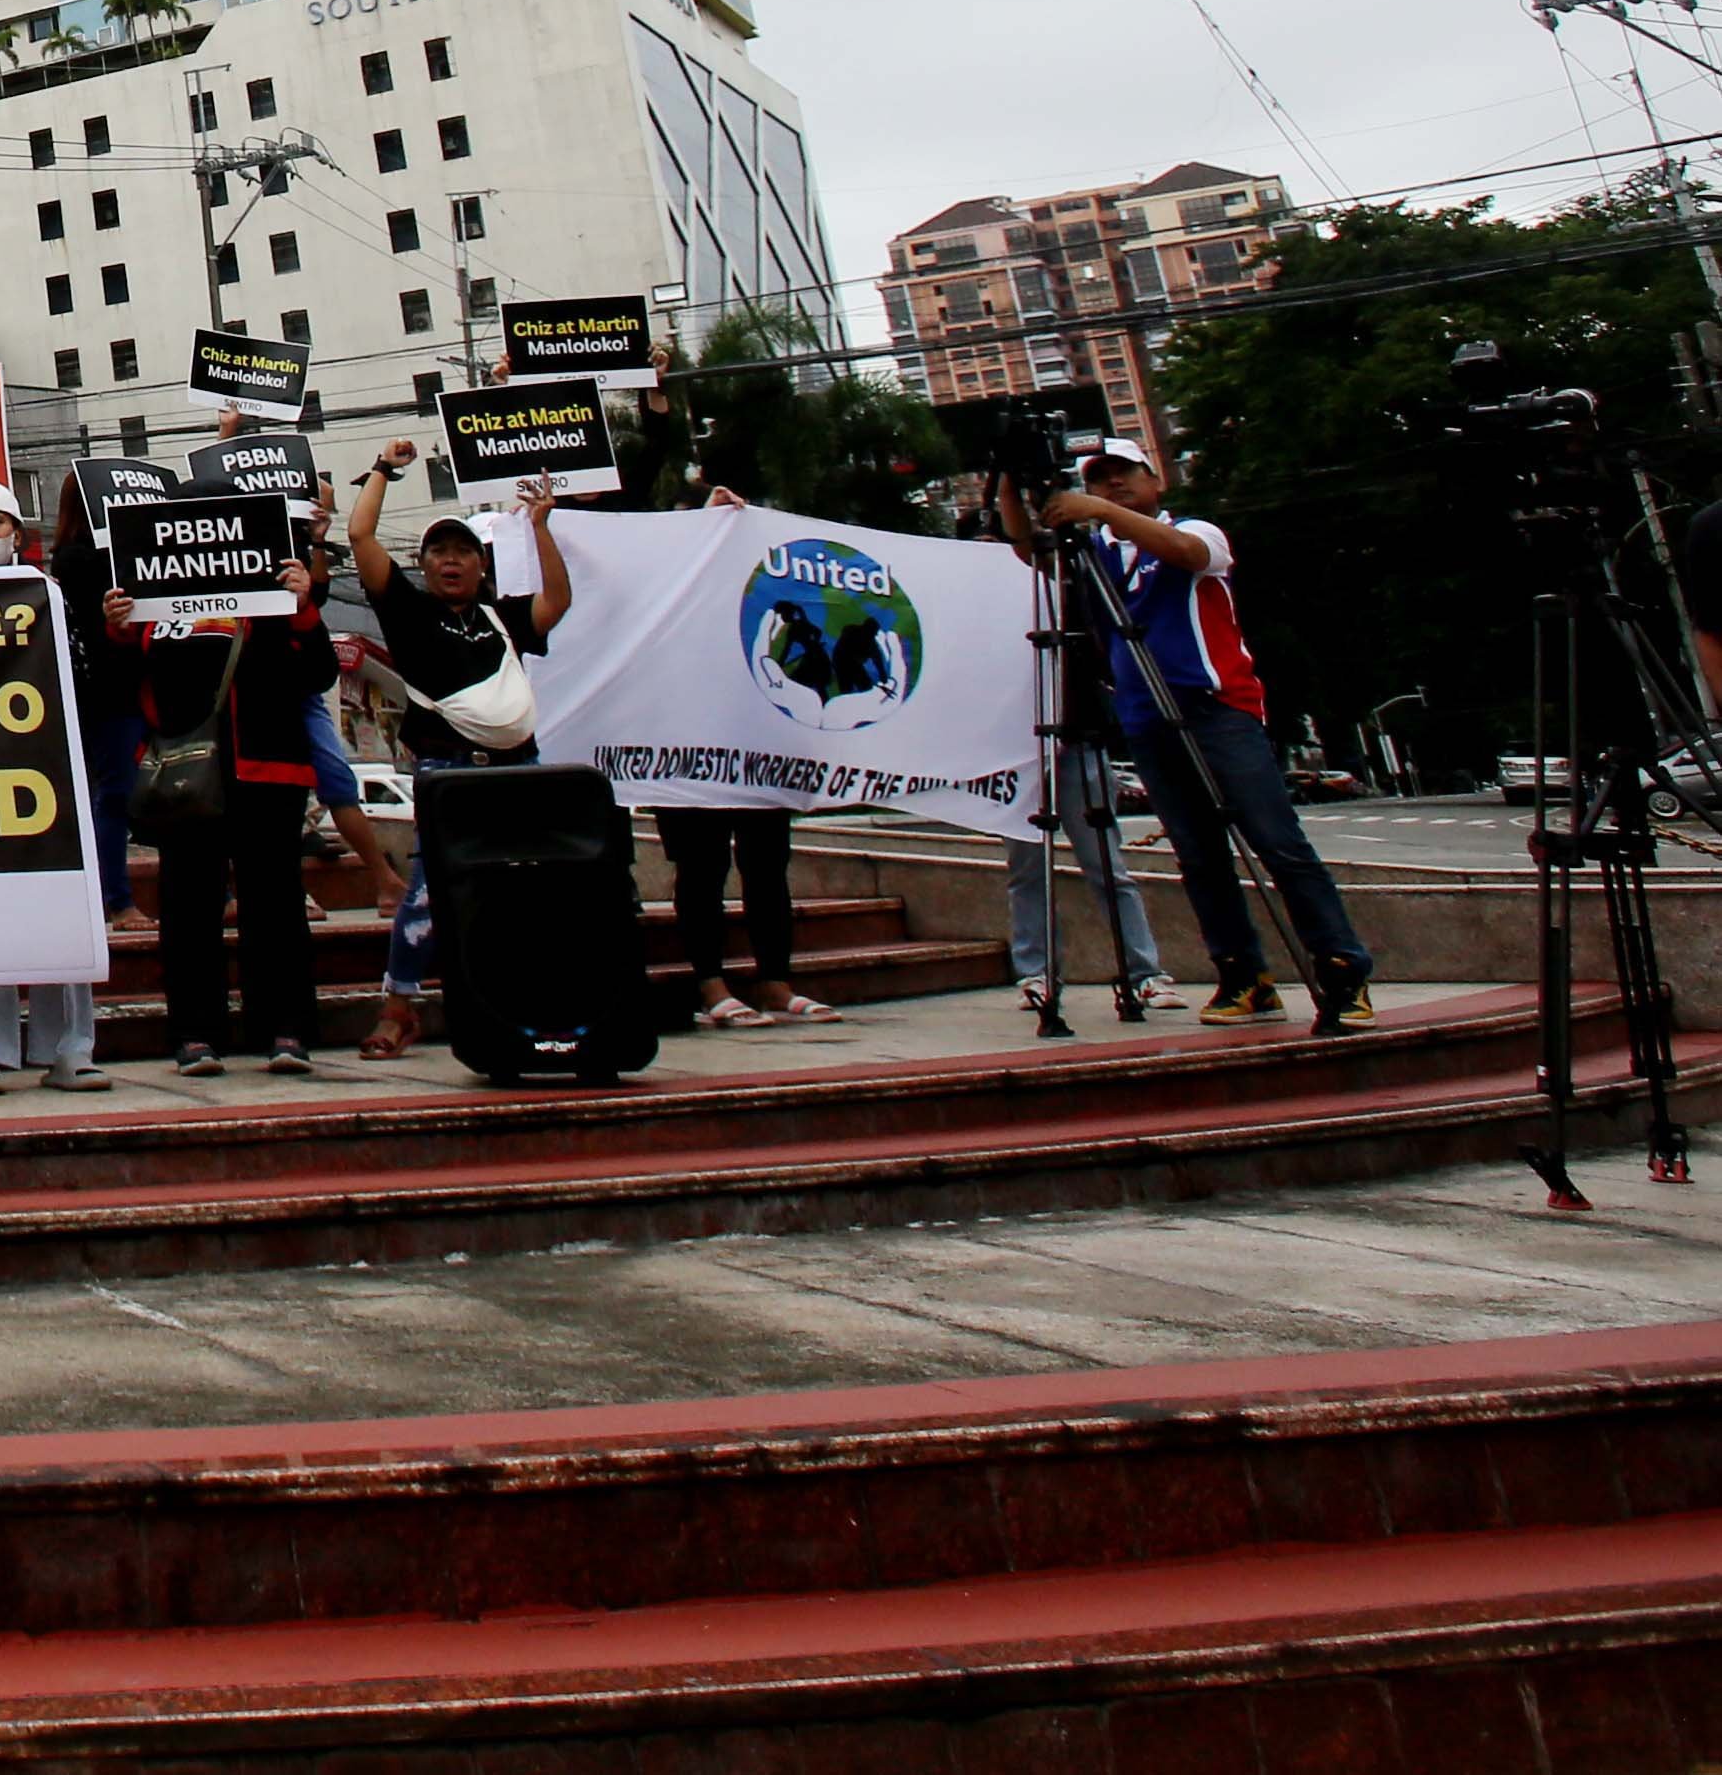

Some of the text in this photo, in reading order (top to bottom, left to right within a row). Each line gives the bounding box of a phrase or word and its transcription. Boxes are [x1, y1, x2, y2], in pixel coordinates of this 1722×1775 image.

[513, 315, 640, 337] Chiz at Martin
[527, 336, 630, 356] Manloloko!
[200, 346, 300, 374] Chiz at Martin
[207, 364, 288, 390] Manloloko!
[456, 403, 594, 434] Chiz at Martin
[476, 428, 587, 458] Manloloko!
[221, 446, 288, 472] PBBM
[110, 469, 165, 493] PBBM
[233, 470, 308, 493] ANHID!
[516, 476, 569, 492] SNRO
[155, 516, 245, 546] PBBM
[135, 548, 273, 581] MANHID!
[762, 545, 892, 598] United
[172, 597, 238, 614] SENTRO
[594, 745, 654, 782] UNITED
[655, 747, 741, 785] DOMESTIC
[742, 752, 828, 795] WORKERS
[828, 764, 860, 799] OF
[861, 769, 903, 802] THE
